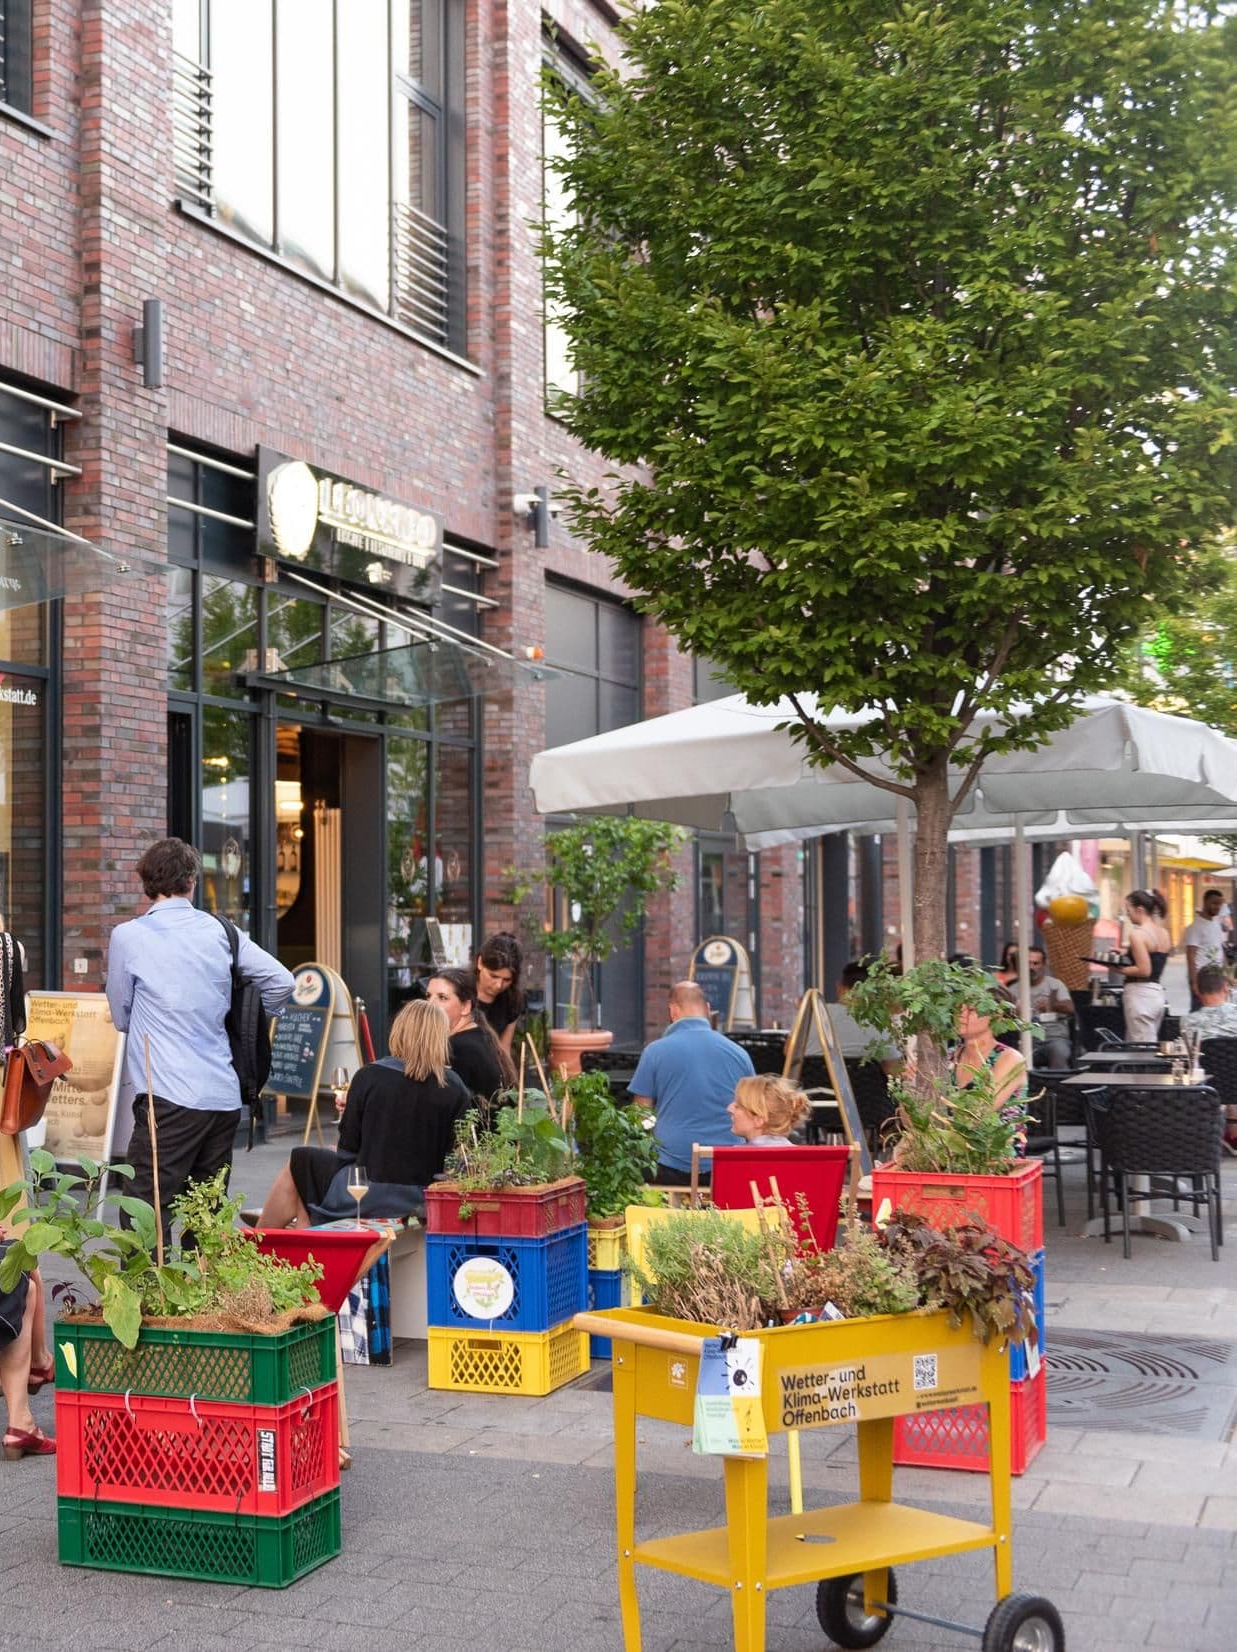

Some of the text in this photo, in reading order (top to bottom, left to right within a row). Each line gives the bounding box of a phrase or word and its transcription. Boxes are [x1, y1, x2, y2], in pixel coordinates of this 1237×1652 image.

[780, 1365, 866, 1391] Wetter- und
[783, 1379, 900, 1410] Klima-Werkstatt
[782, 1402, 856, 1427] Offenbach
